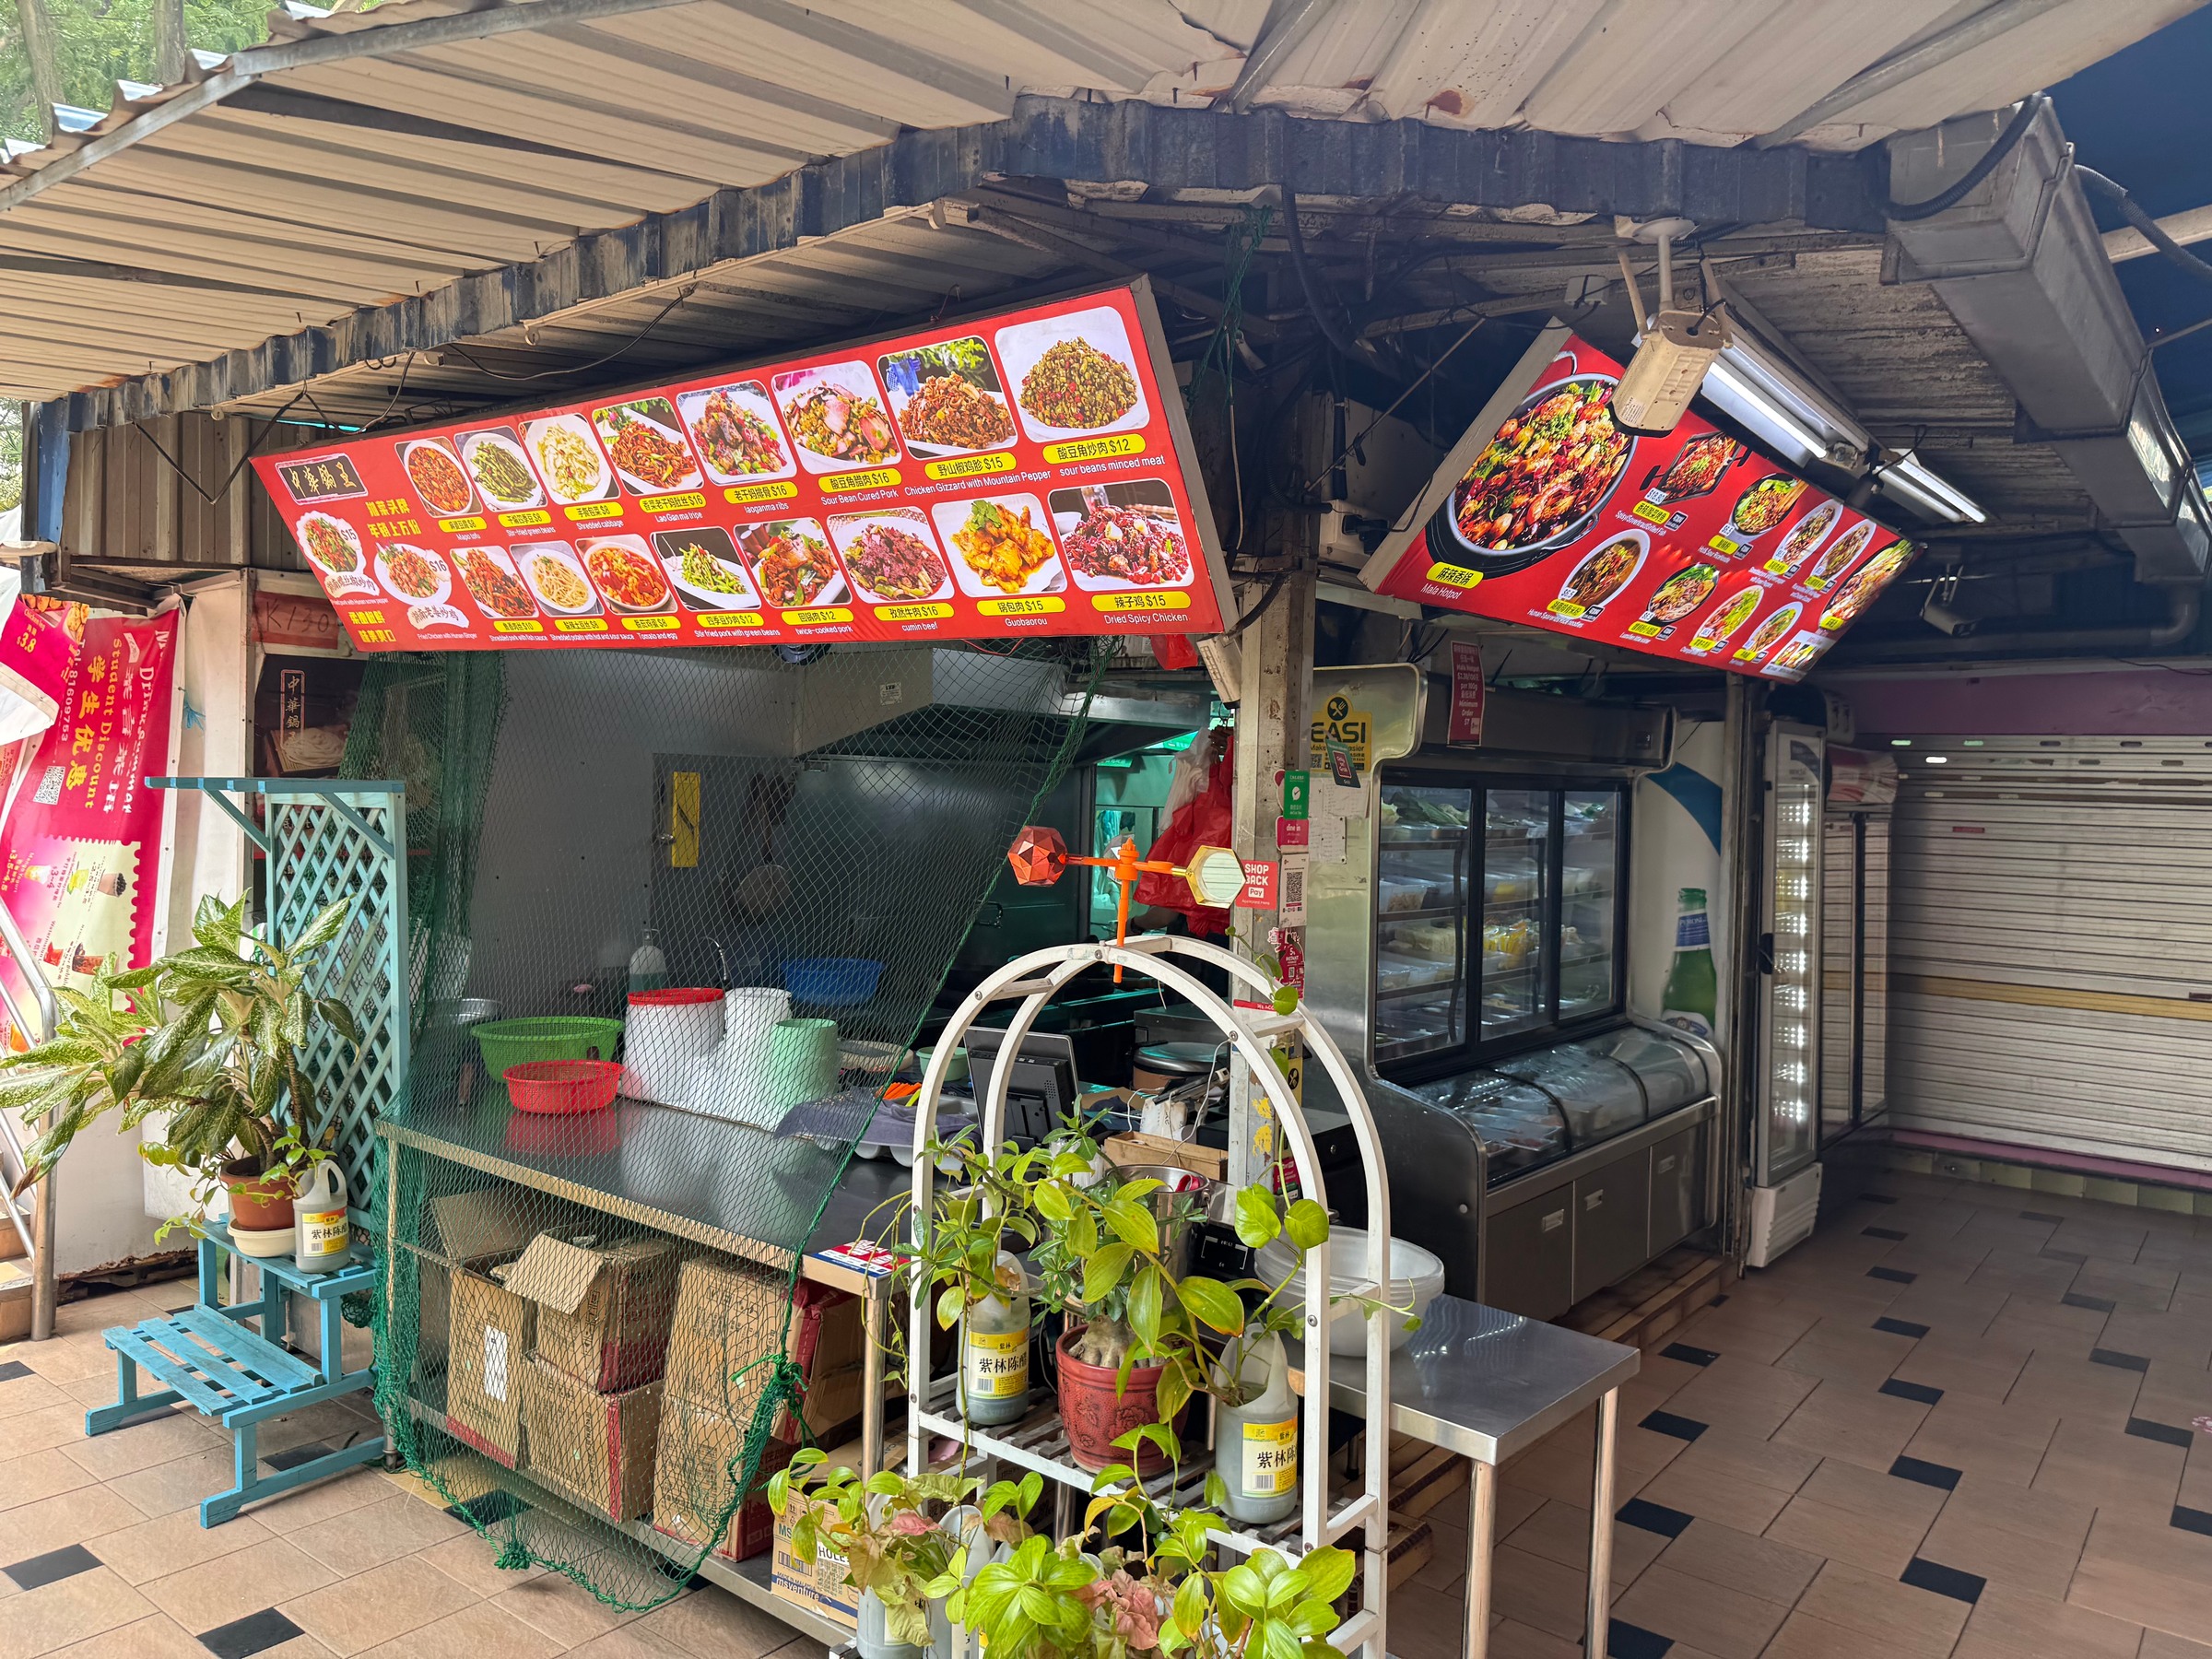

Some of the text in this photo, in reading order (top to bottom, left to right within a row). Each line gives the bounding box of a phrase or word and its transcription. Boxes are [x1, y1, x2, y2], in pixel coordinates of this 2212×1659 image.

[1055, 438, 1130, 460] 酸豆角炒肉 $12
[982, 455, 1004, 470] $15
[1058, 454, 1165, 477] sour beans minced meat
[829, 471, 890, 489] 酸豆角腊肉 $16
[903, 469, 1052, 495] Chicken Gizzard with Mountain Pepper
[733, 484, 788, 501] 老干妈排骨 $16
[820, 488, 899, 505] Sour Bean Cured Pork
[687, 494, 703, 506] $16
[743, 500, 789, 513] laoganma ribs
[599, 504, 611, 515] $8
[654, 514, 667, 523] Lao
[665, 512, 680, 522] Gan
[687, 510, 703, 520] tripe
[367, 519, 422, 538] 年销上万份
[505, 525, 556, 537] Stir-fried green beans
[575, 518, 625, 530] Shredded cabbage
[1656, 527, 1667, 535] Fish
[340, 528, 356, 542] $15
[455, 533, 471, 541] Mapo
[432, 559, 447, 572] $16
[1436, 567, 1472, 584] 麻辣香锅
[1419, 583, 1462, 600] Mala Hotpot
[996, 600, 1043, 612] 锅包肉 $15
[1113, 595, 1166, 607] 辣子鸡 $15
[24, 609, 38, 624] Chicken
[266, 601, 329, 632] K130
[797, 611, 836, 621] 回锅肉 $12
[888, 606, 939, 618] 孜然牛肉 $16
[1103, 612, 1188, 624] Dried Spicy Chicken
[1526, 608, 1543, 618] Hunan
[656, 618, 668, 627] $8
[705, 615, 754, 625] 四季豆炒肉 $12
[922, 621, 938, 629] beef
[1004, 617, 1048, 626] Guobaorou
[717, 629, 733, 638] pork
[794, 626, 838, 634] twice-cooked
[17, 632, 36, 653] $3.8
[61, 670, 78, 741] 81609753
[65, 654, 106, 791] 学生优惠
[84, 638, 123, 809] Student Discount
[1312, 723, 1366, 743] EASI
[18, 852, 35, 873] Mango
[1245, 864, 1269, 875] SHOP
[13, 871, 27, 893] Yogurt
[39, 920, 56, 958] Watermelon
[979, 1352, 1027, 1373] 紫林陈醋
[777, 1578, 819, 1601] msventure
